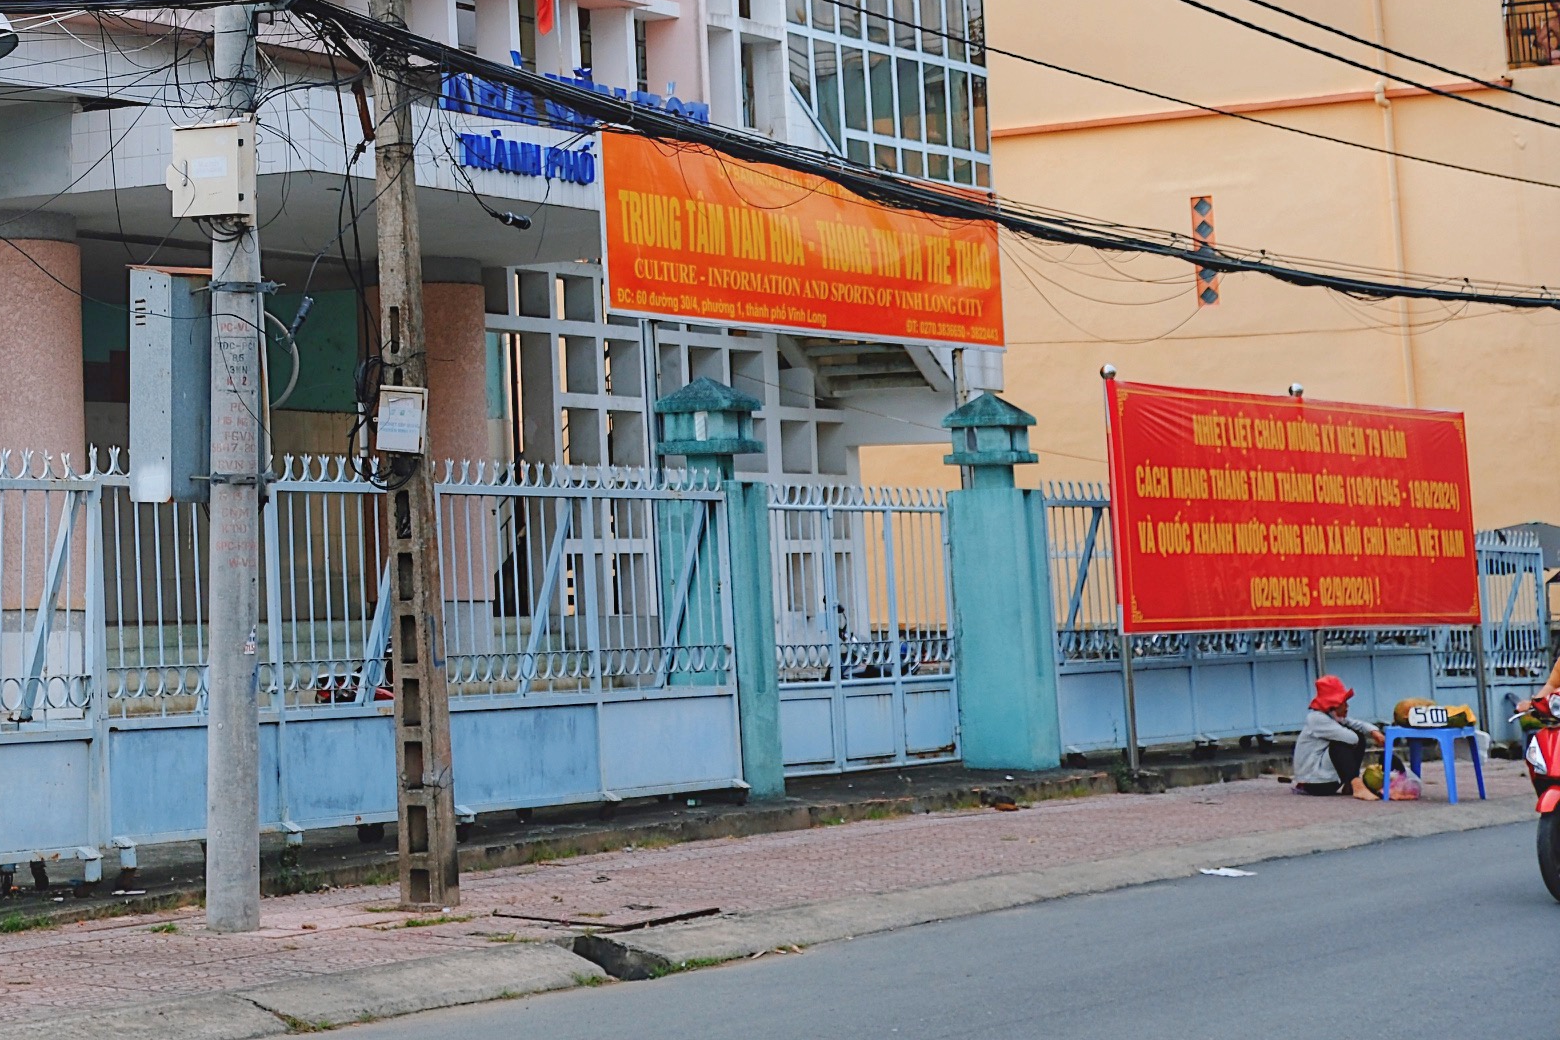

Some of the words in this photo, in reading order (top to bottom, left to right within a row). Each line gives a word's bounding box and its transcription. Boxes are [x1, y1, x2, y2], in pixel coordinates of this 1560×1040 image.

[460, 129, 541, 177] THÀNH
[542, 141, 595, 185] PHỐ
[618, 189, 682, 250] TRUNG
[686, 190, 726, 256] TÂM
[728, 198, 766, 261] VĂN
[808, 241, 816, 251] -
[816, 213, 873, 275] THÔNG
[873, 228, 901, 278] TIN
[902, 224, 923, 281] VÀ
[954, 240, 990, 289] THAO
[617, 287, 635, 303] ĐC:
[636, 289, 647, 305] 60
[649, 292, 678, 312] đường
[702, 298, 735, 318] phường
[745, 302, 769, 318] thành
[771, 303, 786, 322] phố
[787, 305, 805, 321] Vĩnh
[807, 310, 827, 327] Long
[634, 258, 697, 284] CULTURE
[708, 267, 801, 296] INFORMATION
[803, 279, 829, 301] AND
[831, 282, 875, 306] SPORTS
[876, 288, 893, 307] OF
[894, 290, 924, 312] VINH
[925, 293, 956, 315] LONG
[957, 297, 983, 318] CITY
[1192, 409, 1227, 453] NHIỆT
[1228, 411, 1252, 455] LIỆT
[1254, 413, 1285, 451] CHÀO
[1286, 415, 1321, 453] MỪNG
[1321, 415, 1336, 454] KỶ
[1337, 420, 1366, 461] NIỆM
[1366, 428, 1381, 457] 79
[1381, 424, 1407, 458] NĂM
[1136, 459, 1170, 498] CÁCH
[1171, 466, 1209, 506] MẠNG
[1209, 462, 1249, 501] THÁNG
[1249, 464, 1276, 501] TÁM
[1276, 466, 1315, 503] THÀNH
[1315, 468, 1345, 504] CÔNG
[1346, 476, 1401, 507] (19/8/1945
[1408, 480, 1460, 512] 19/8/2024)
[1138, 514, 1156, 553] VÀ
[1157, 511, 1191, 557] QUỐC
[1192, 515, 1234, 554] KHÁNH
[1235, 516, 1268, 554] NƯỚC
[1269, 518, 1302, 561] CỘNG
[1302, 517, 1326, 555] HÒA
[1327, 520, 1342, 555] XÃ
[1343, 520, 1362, 561] HỘI
[1363, 517, 1385, 556] CHỦ
[1385, 522, 1418, 557] NGHĨA
[1418, 523, 1439, 563] VIỆT
[1441, 529, 1465, 558] NAM
[1250, 576, 1310, 610] (02/9/1945
[1319, 576, 1374, 608] 02/9/2024)
